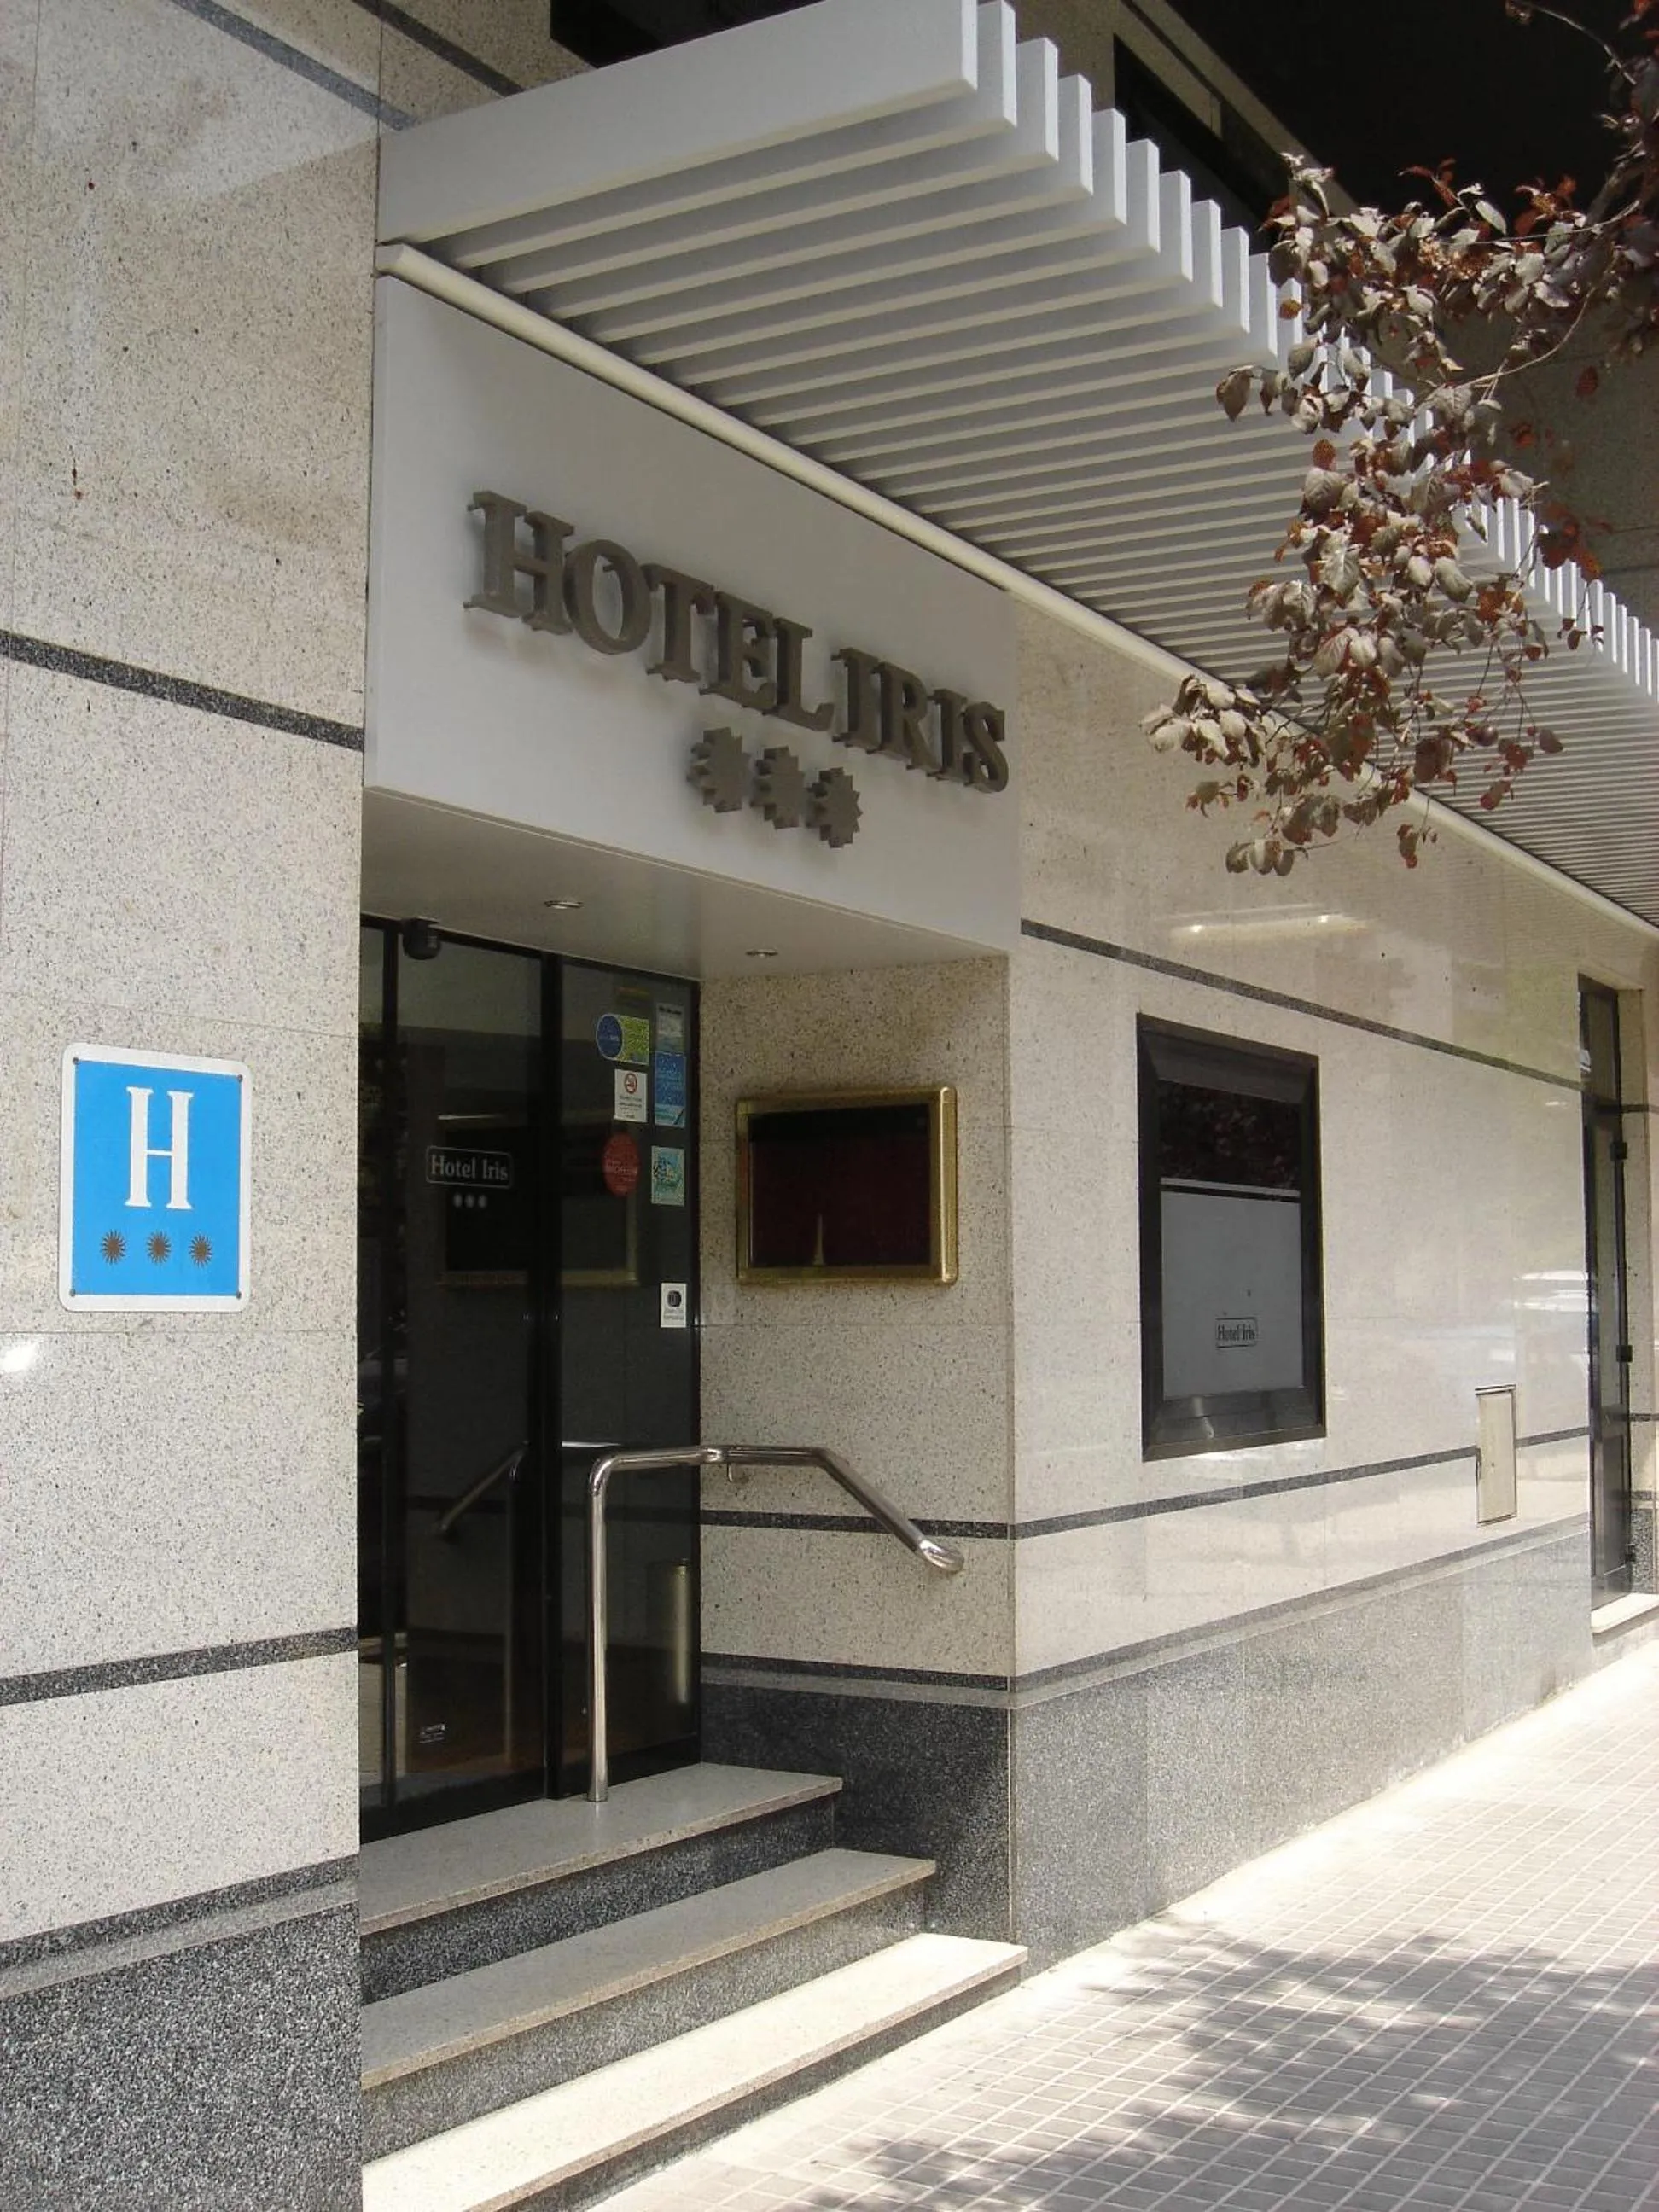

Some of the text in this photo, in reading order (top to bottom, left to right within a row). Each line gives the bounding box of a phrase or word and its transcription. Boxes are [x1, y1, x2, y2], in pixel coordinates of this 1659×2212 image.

[463, 490, 1010, 793] HOTEL IRIS
[125, 1086, 194, 1210] H
[430, 1154, 509, 1180] Hotel Iris
